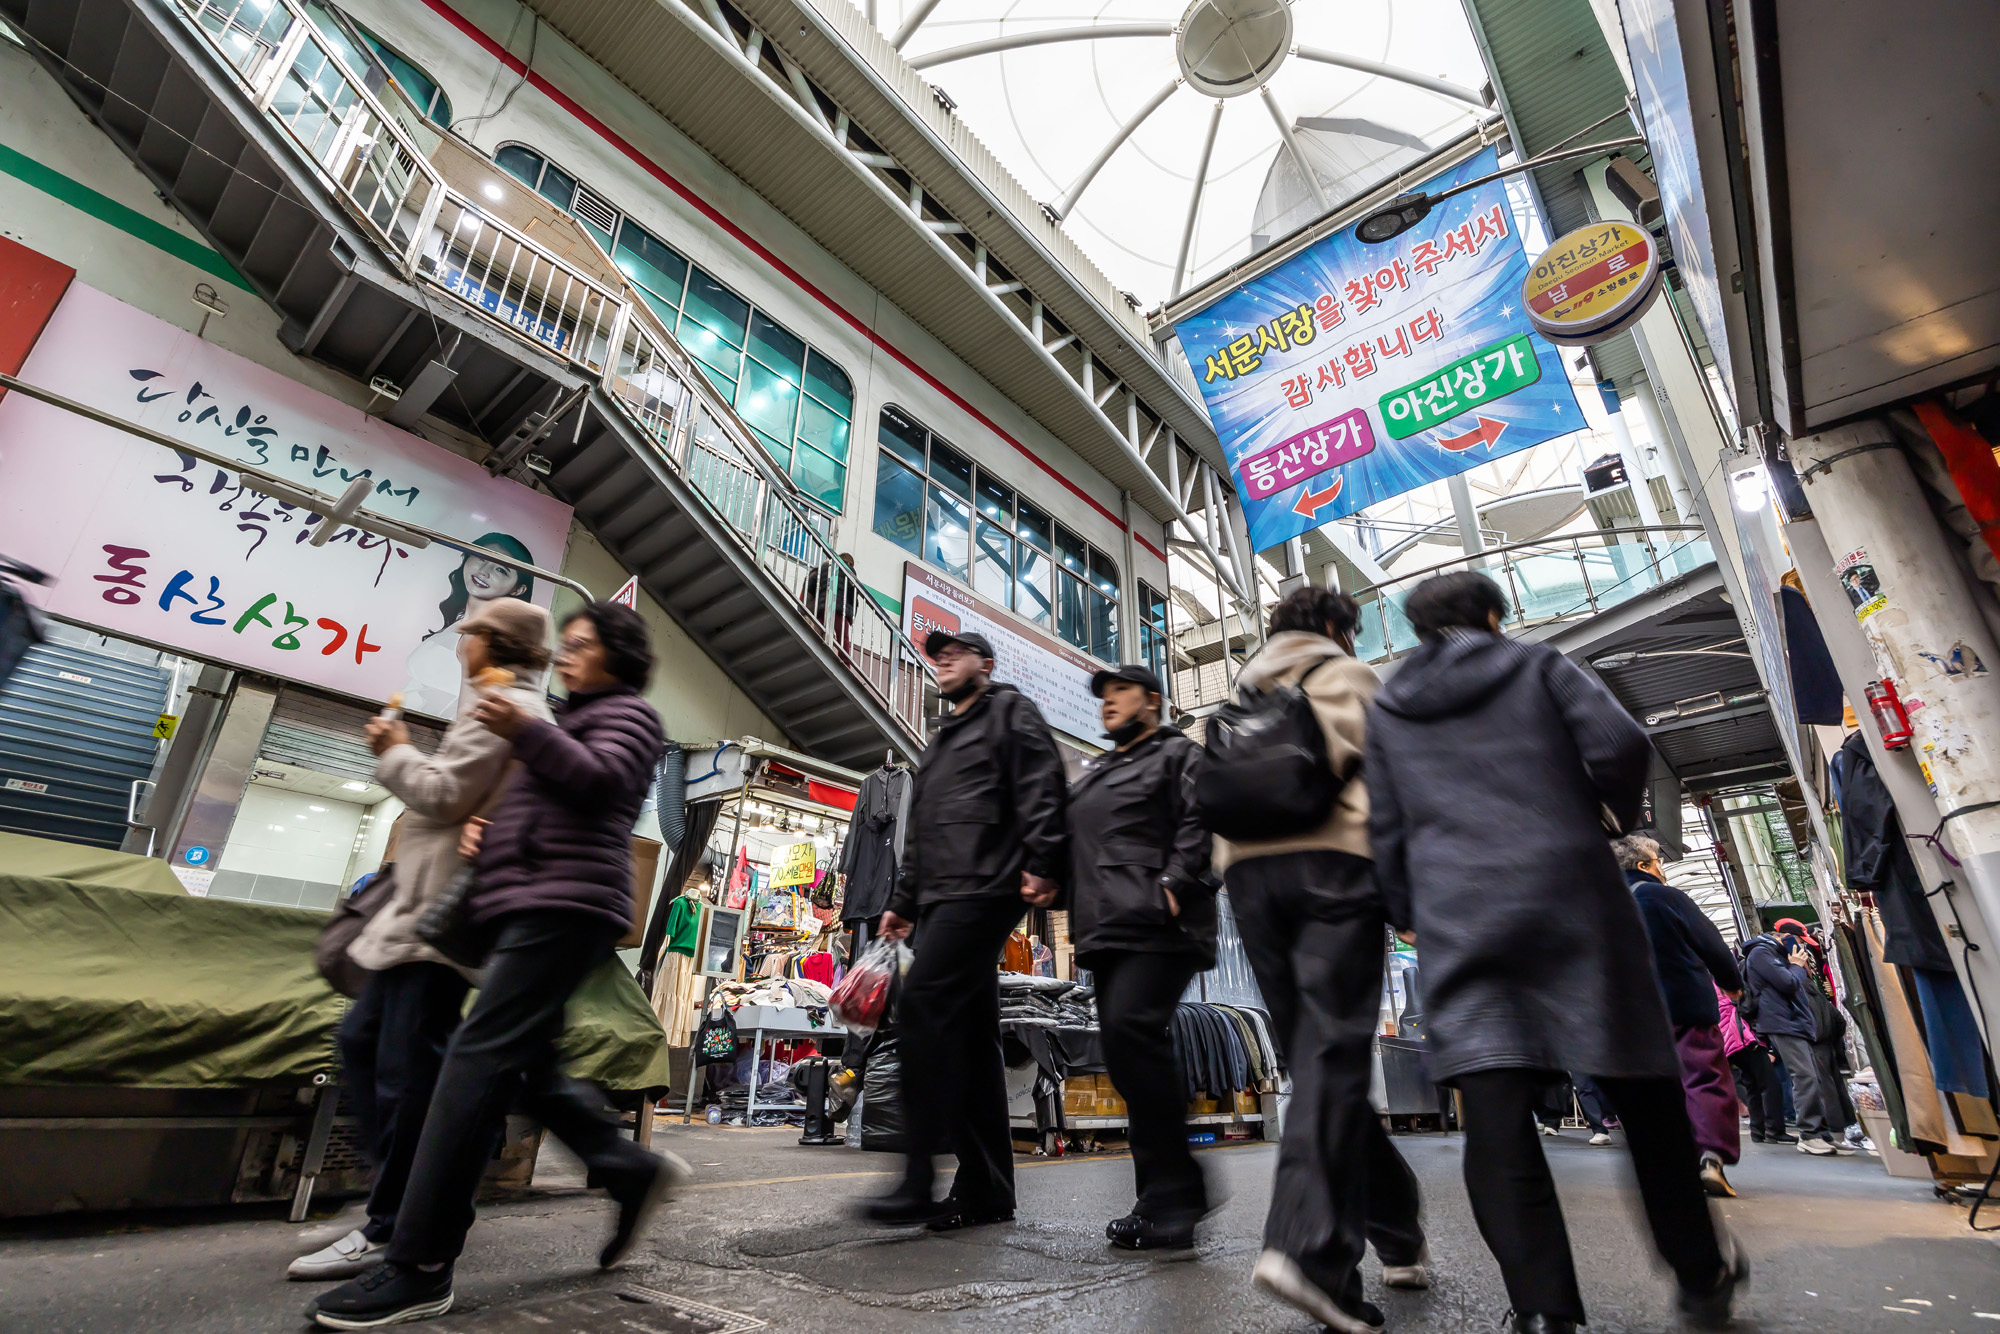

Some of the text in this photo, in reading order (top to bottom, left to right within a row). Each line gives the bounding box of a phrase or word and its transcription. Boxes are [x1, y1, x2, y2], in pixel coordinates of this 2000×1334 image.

[1535, 227, 1622, 280] 아진상가
[1538, 239, 1629, 291] Daegu Seomun Market
[1548, 254, 1630, 304] 남 로
[1572, 271, 1640, 310] 119 소방통로
[1204, 205, 1507, 383] 서문시장을 찾아 주셔서
[1281, 307, 1442, 408] 감사합니다
[1388, 344, 1525, 422] 아진상가
[129, 369, 420, 507] 당신을 만나서
[1249, 417, 1363, 491] 동산상가
[94, 544, 382, 665] 동산상가
[925, 573, 975, 608] 서문시장 둘러보기
